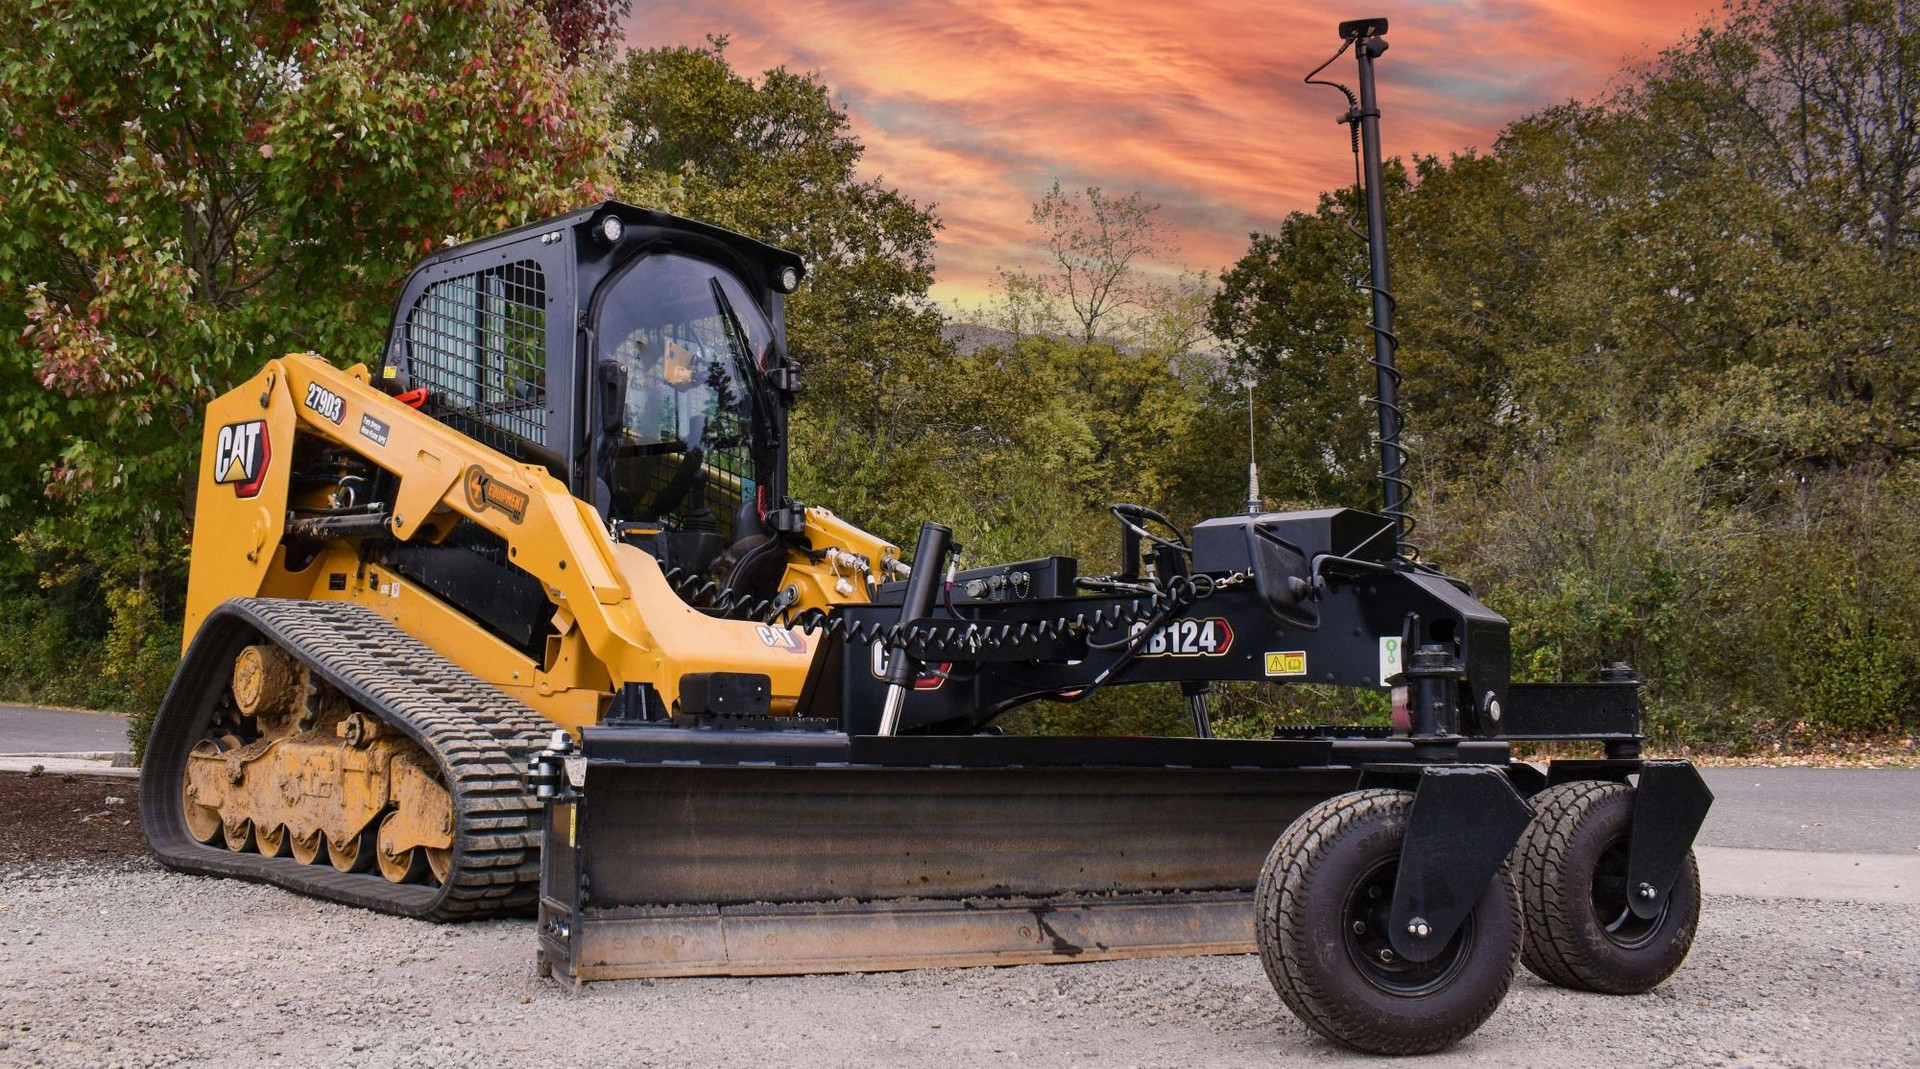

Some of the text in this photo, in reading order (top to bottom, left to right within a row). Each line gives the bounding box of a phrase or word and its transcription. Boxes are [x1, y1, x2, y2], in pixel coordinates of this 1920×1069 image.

[305, 382, 342, 422] 279D3
[217, 421, 261, 482] CAT
[488, 483, 525, 512] EQUIPMENT
[757, 626, 796, 648] CAT
